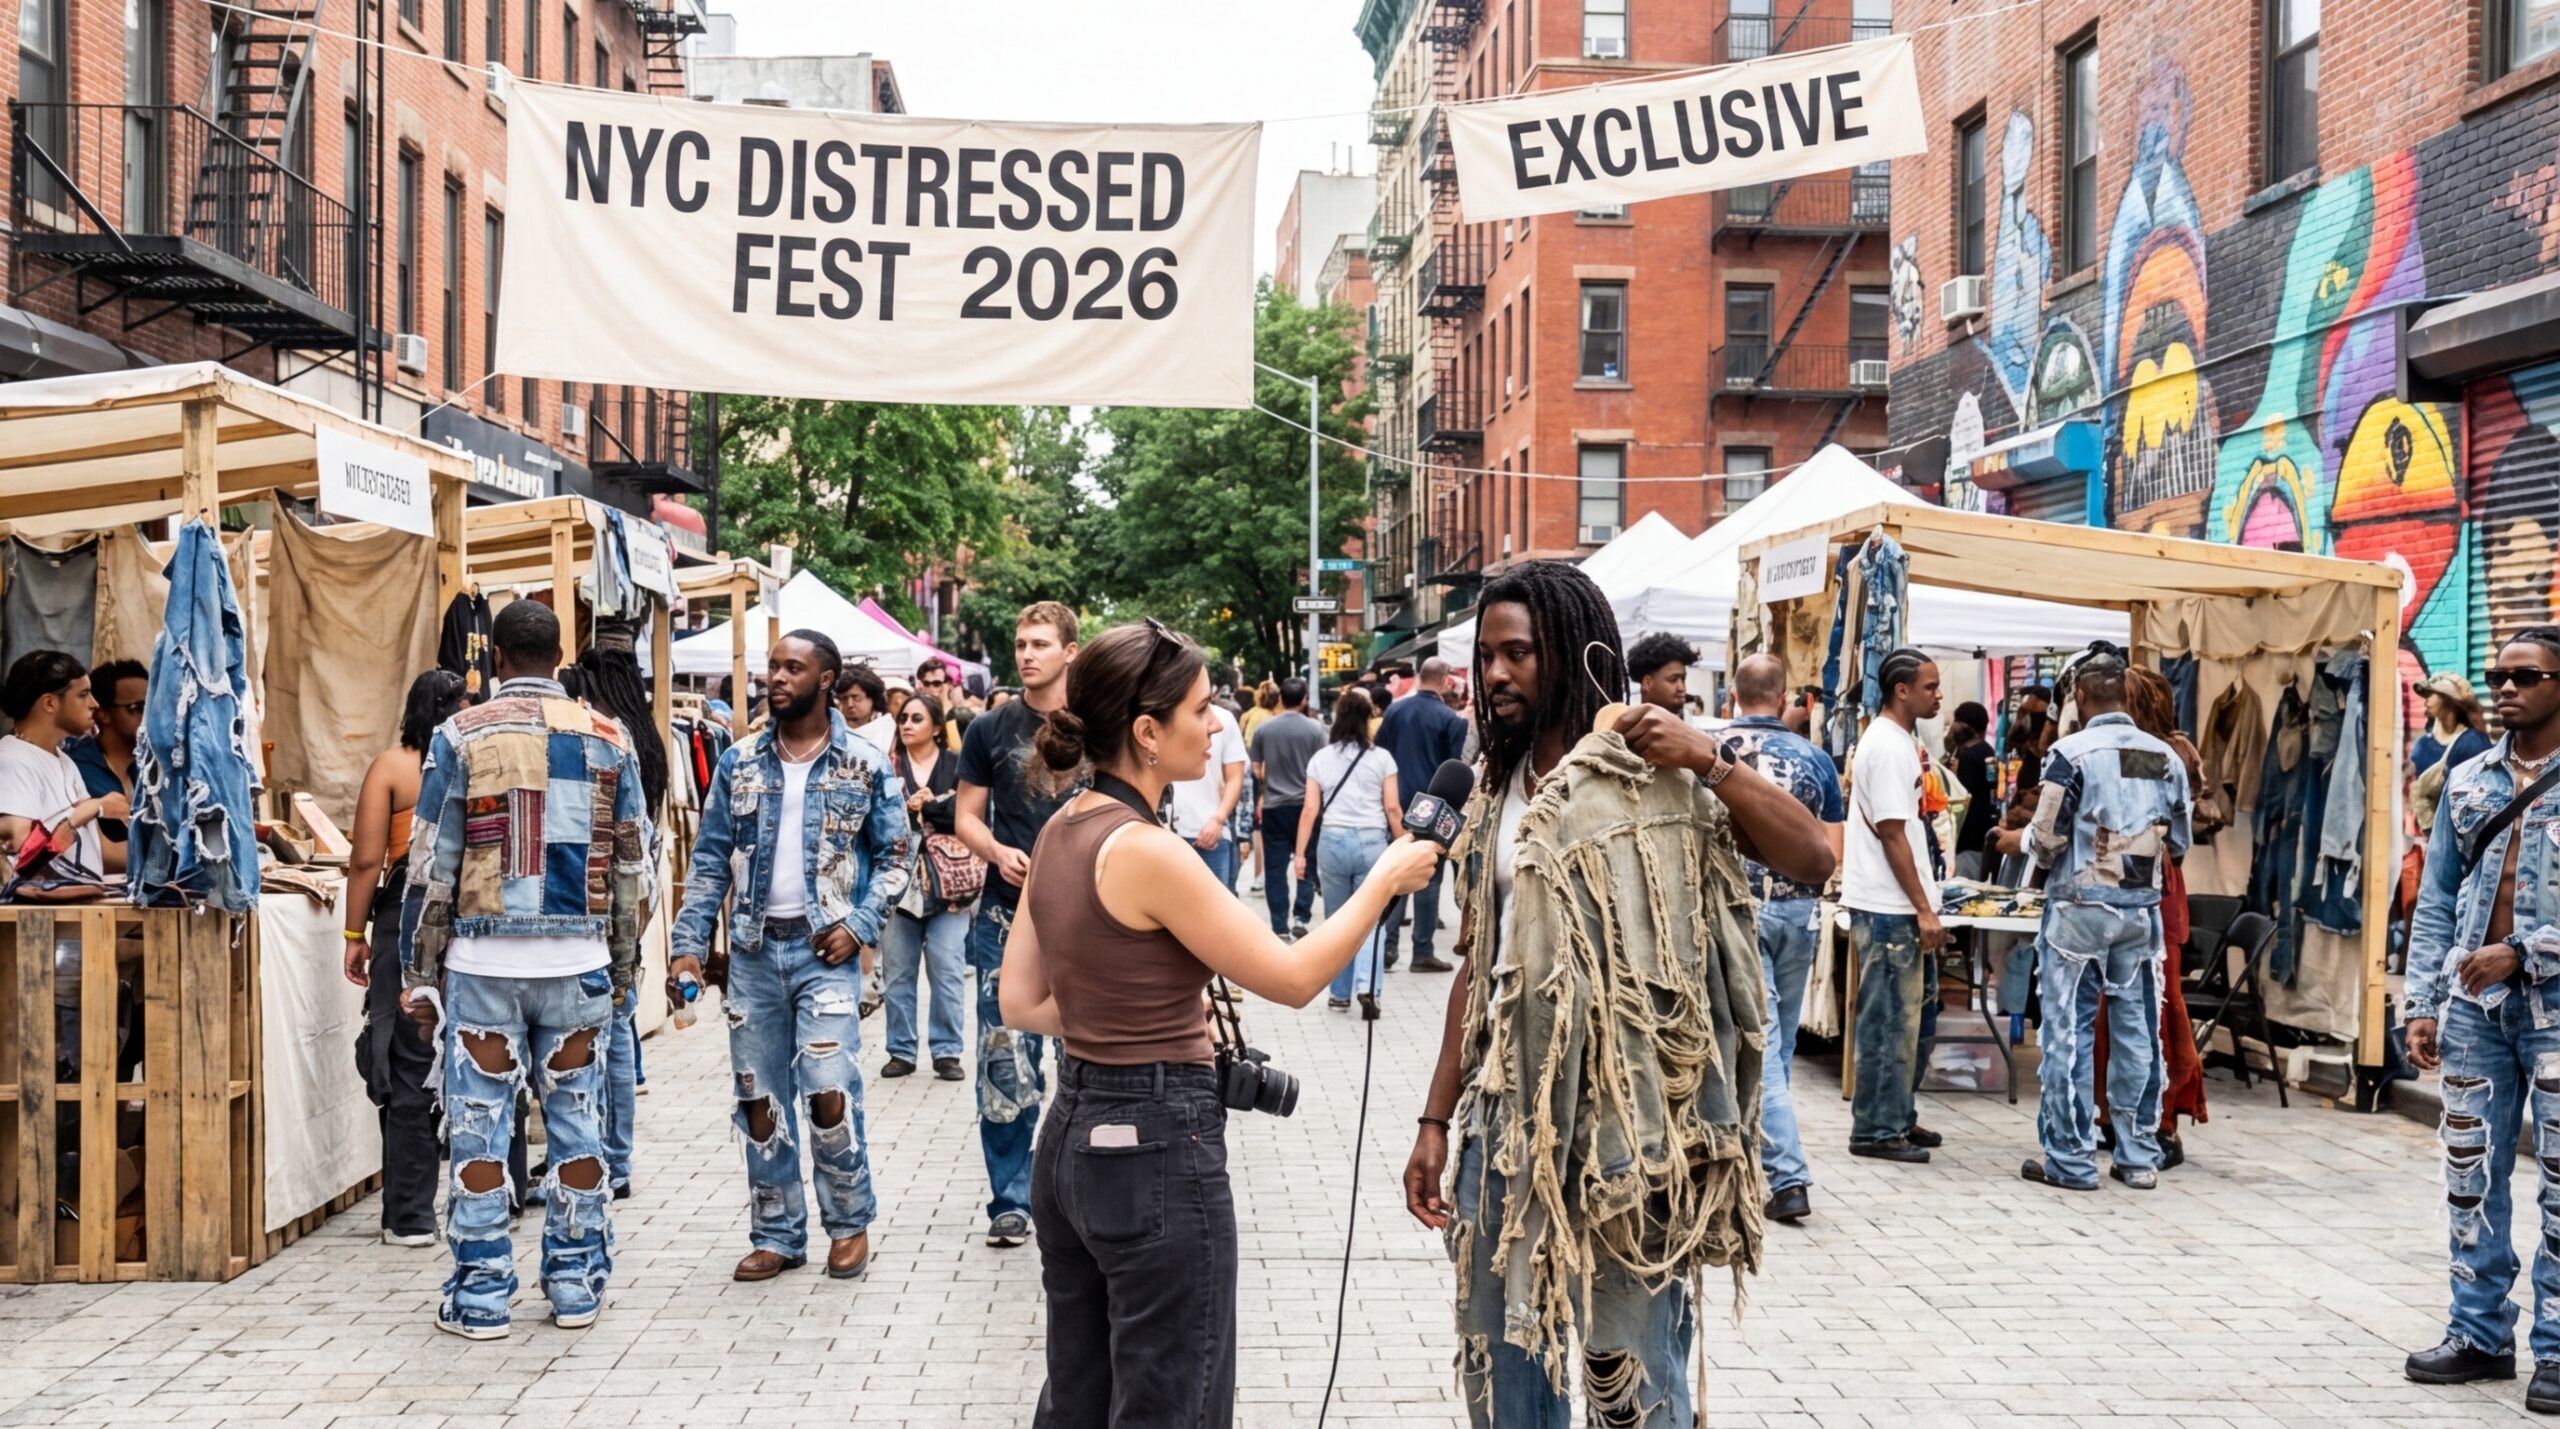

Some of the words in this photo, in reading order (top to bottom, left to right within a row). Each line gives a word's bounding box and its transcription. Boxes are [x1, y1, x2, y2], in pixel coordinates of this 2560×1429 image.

[566, 121, 709, 212] NYC
[738, 137, 1184, 231] DISTRESSED
[1508, 71, 1868, 189] EXCLUSIVE
[733, 233, 910, 320] FEST
[961, 246, 1177, 320] 2026
